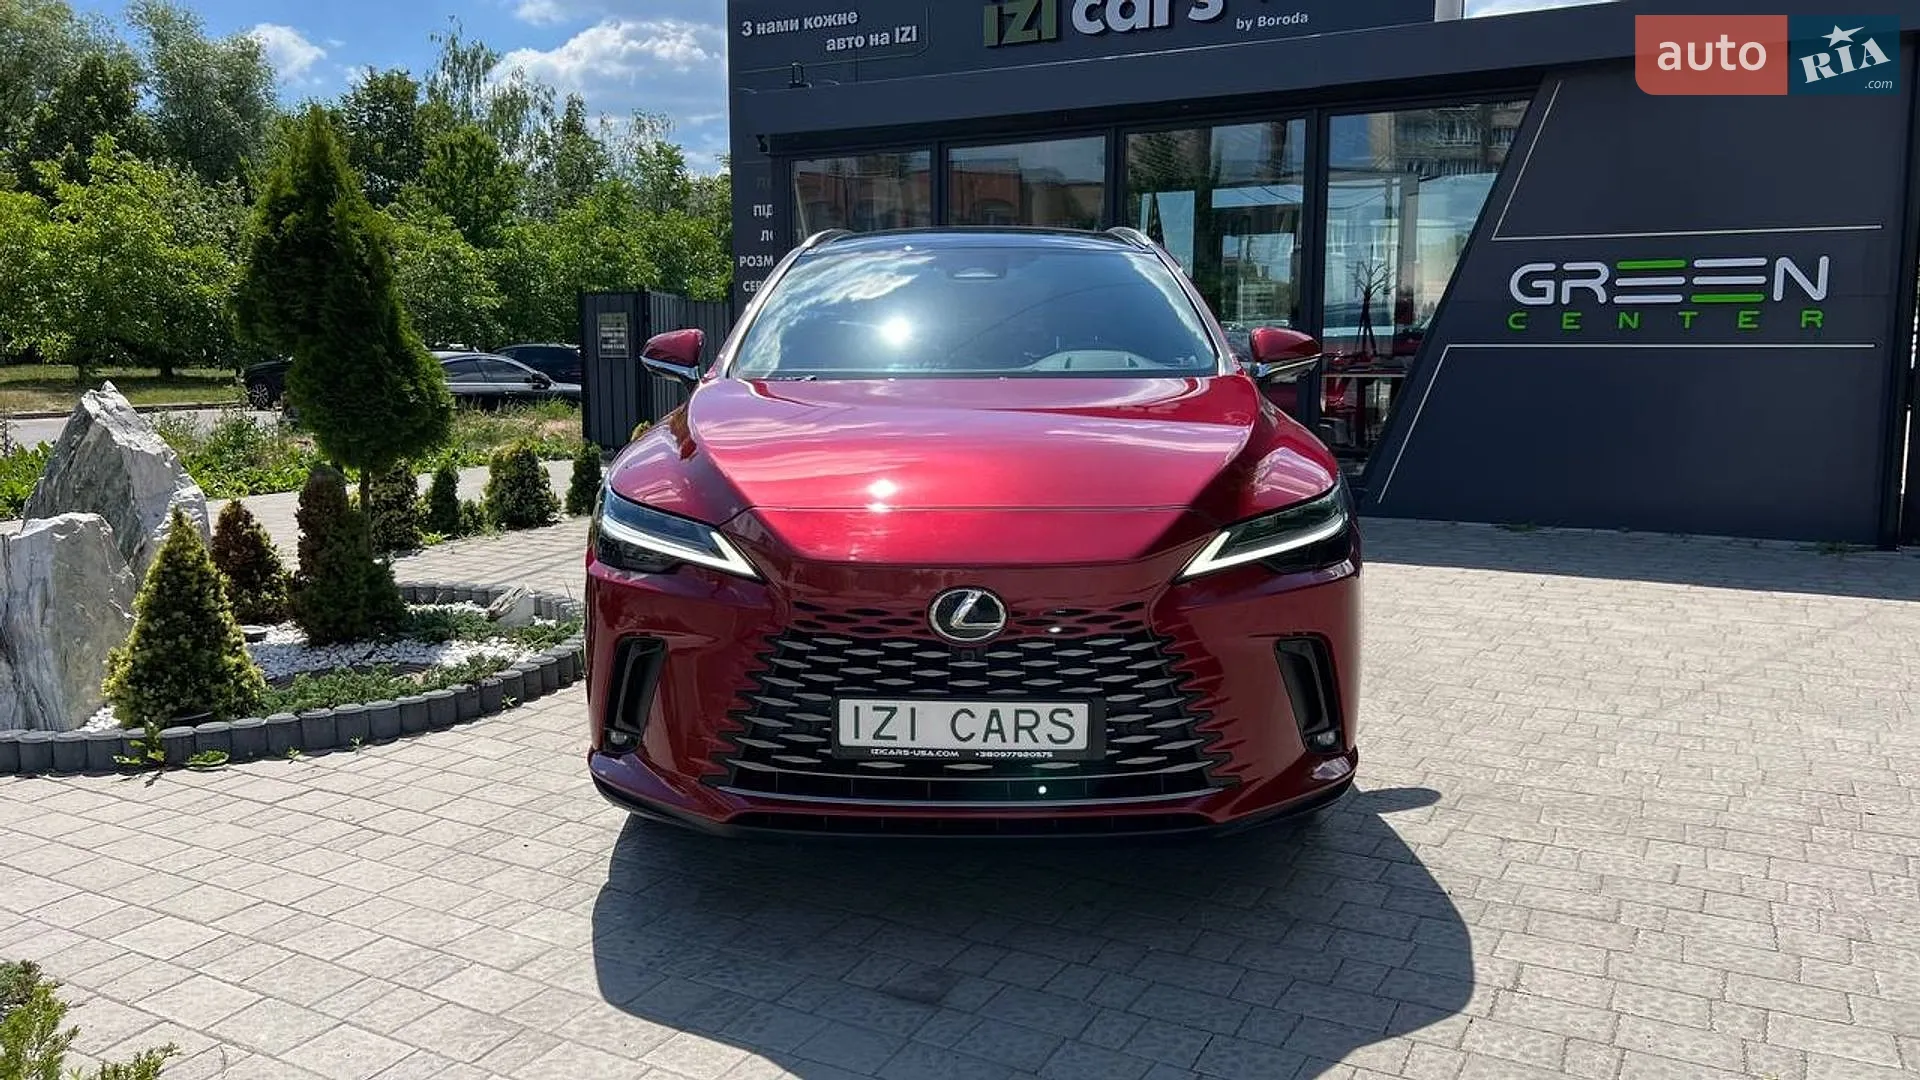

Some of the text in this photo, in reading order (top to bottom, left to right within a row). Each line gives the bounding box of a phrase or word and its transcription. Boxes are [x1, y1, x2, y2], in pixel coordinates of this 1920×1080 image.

[756, 18, 799, 35] нами
[804, 11, 858, 30] кожне
[1236, 12, 1308, 31] by Boroda
[826, 25, 917, 51] авто на IZI
[1509, 256, 1829, 305] GREEN
[1507, 310, 1824, 329] CENTER
[854, 706, 1075, 745] IZI CARS
